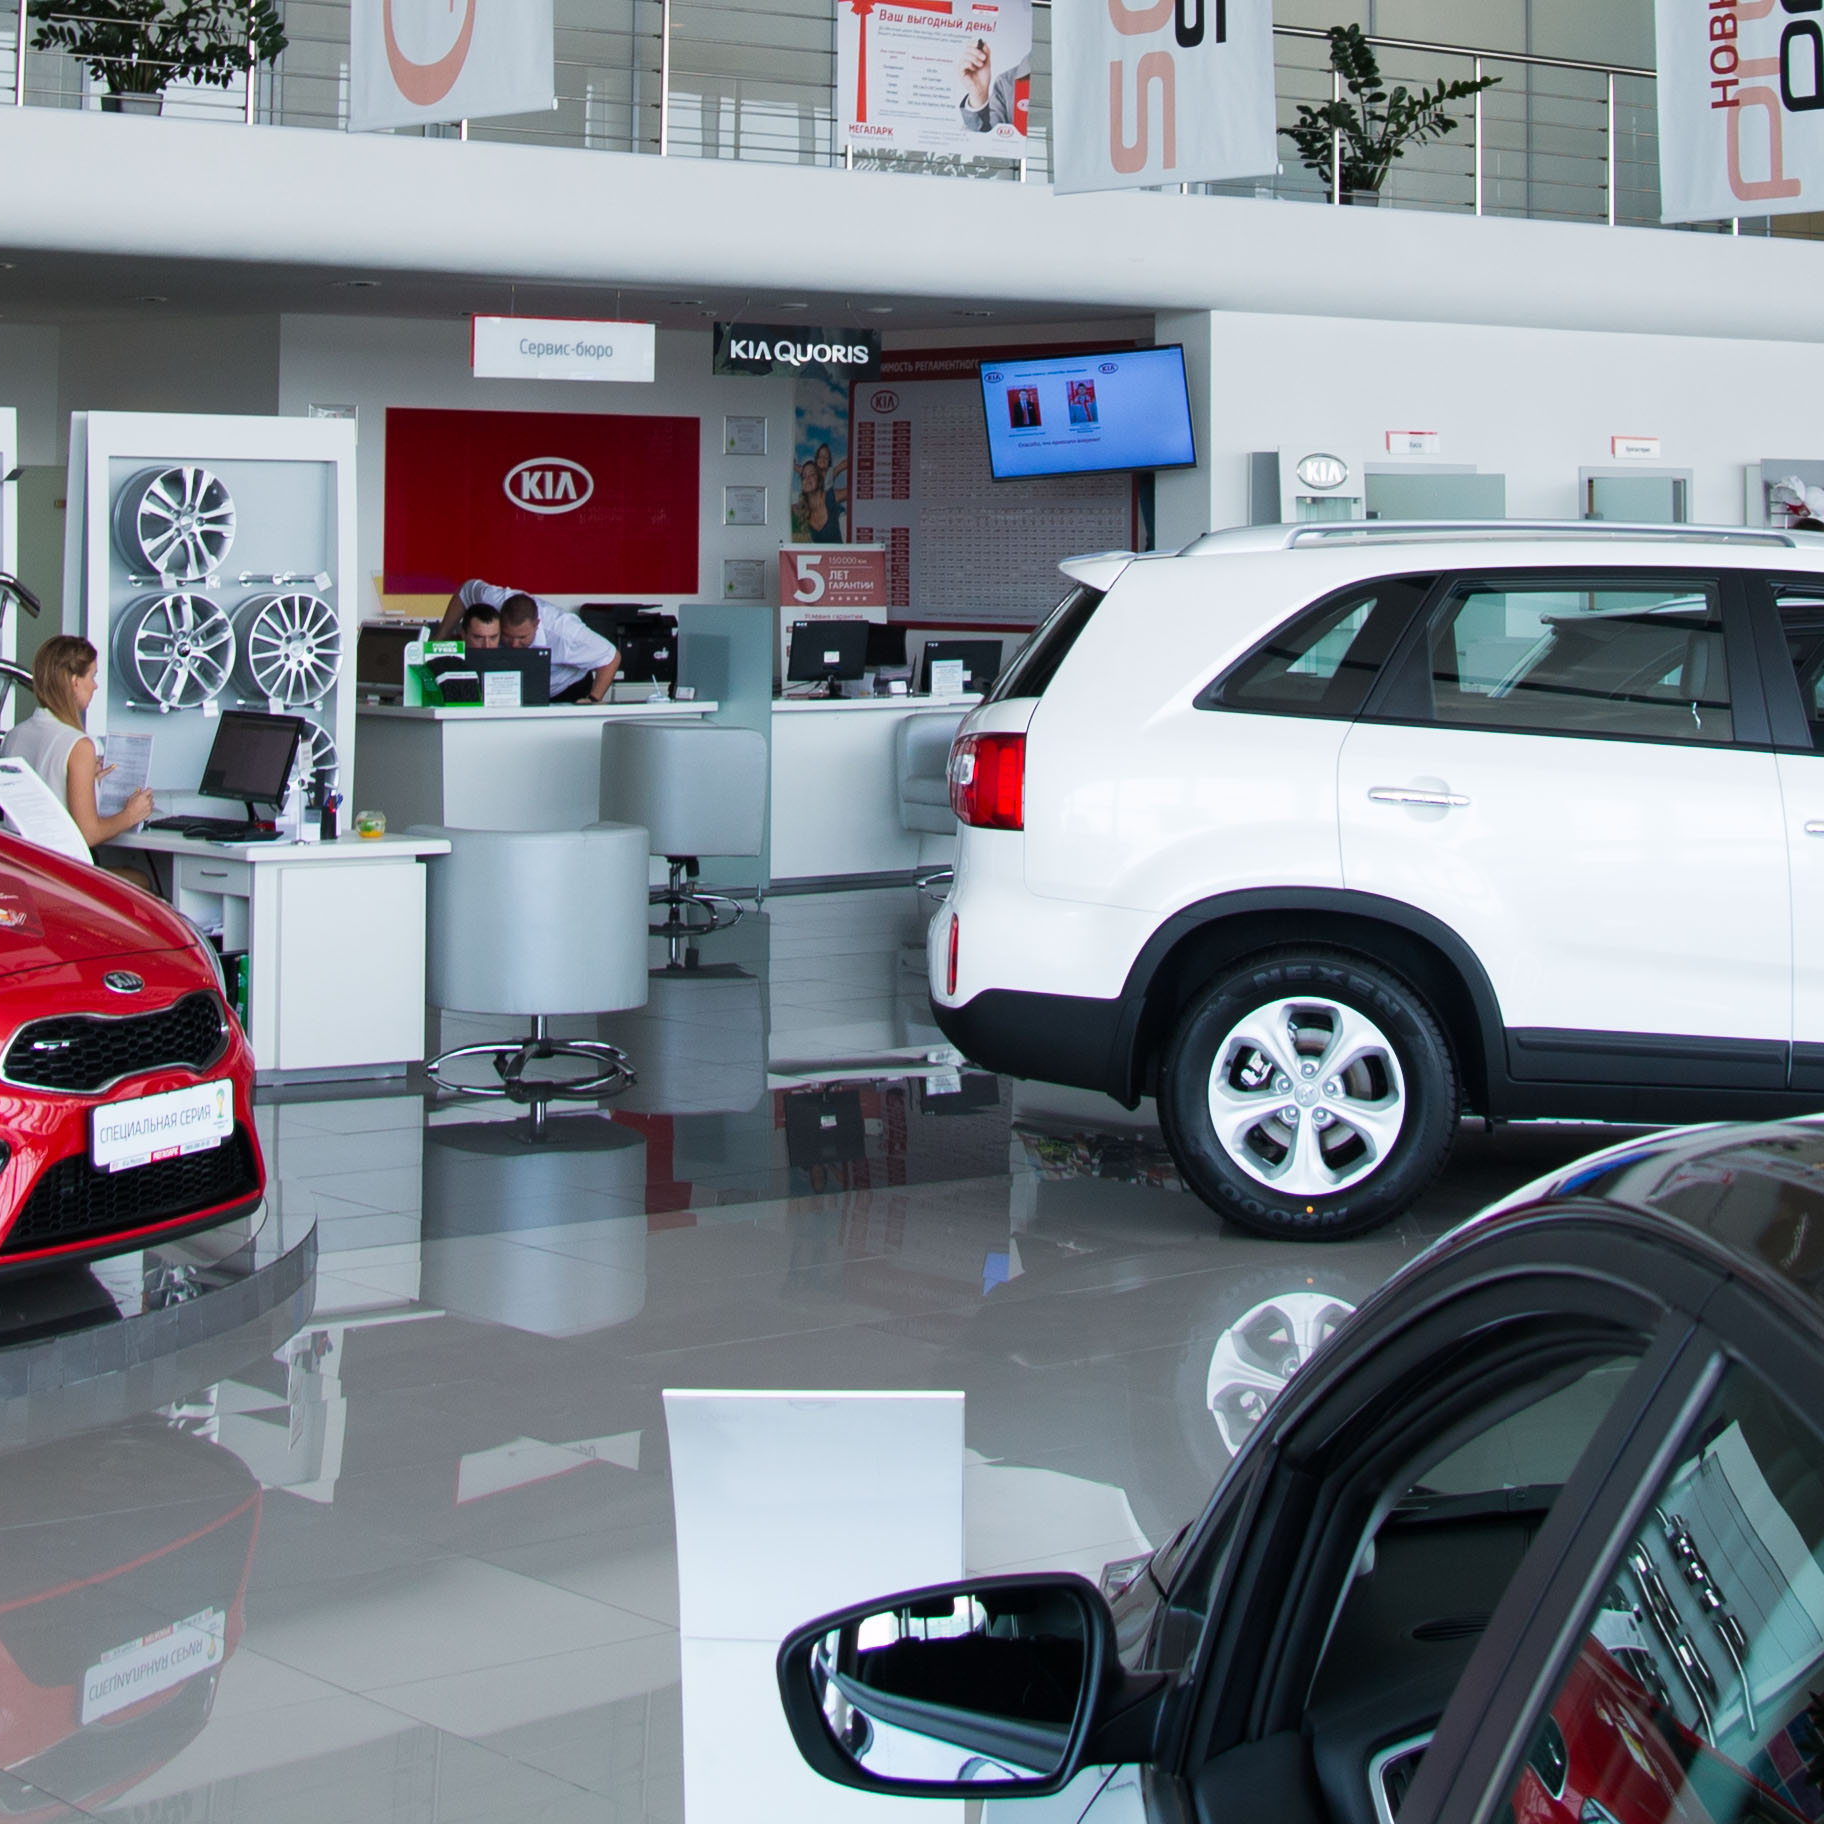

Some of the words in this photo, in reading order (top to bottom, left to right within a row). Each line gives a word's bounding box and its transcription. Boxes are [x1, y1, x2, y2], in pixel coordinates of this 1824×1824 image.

[879, 9, 903, 23] Ваш
[907, 15, 963, 30] выгодный
[965, 20, 997, 33] день!
[848, 124, 894, 136] МЕГАПАРК
[519, 338, 614, 360] Сервис-бюро
[730, 339, 772, 361] KIA
[774, 340, 869, 366] QUORIS
[793, 554, 825, 603] 5
[828, 570, 849, 581] ЛЕТ
[828, 581, 874, 591] ГАРАНТИИ
[1253, 964, 1401, 1017] NEXEN
[99, 1112, 177, 1144] СПЕЦИАЛЬНАЯ
[179, 1104, 212, 1126] СЕРИЯ
